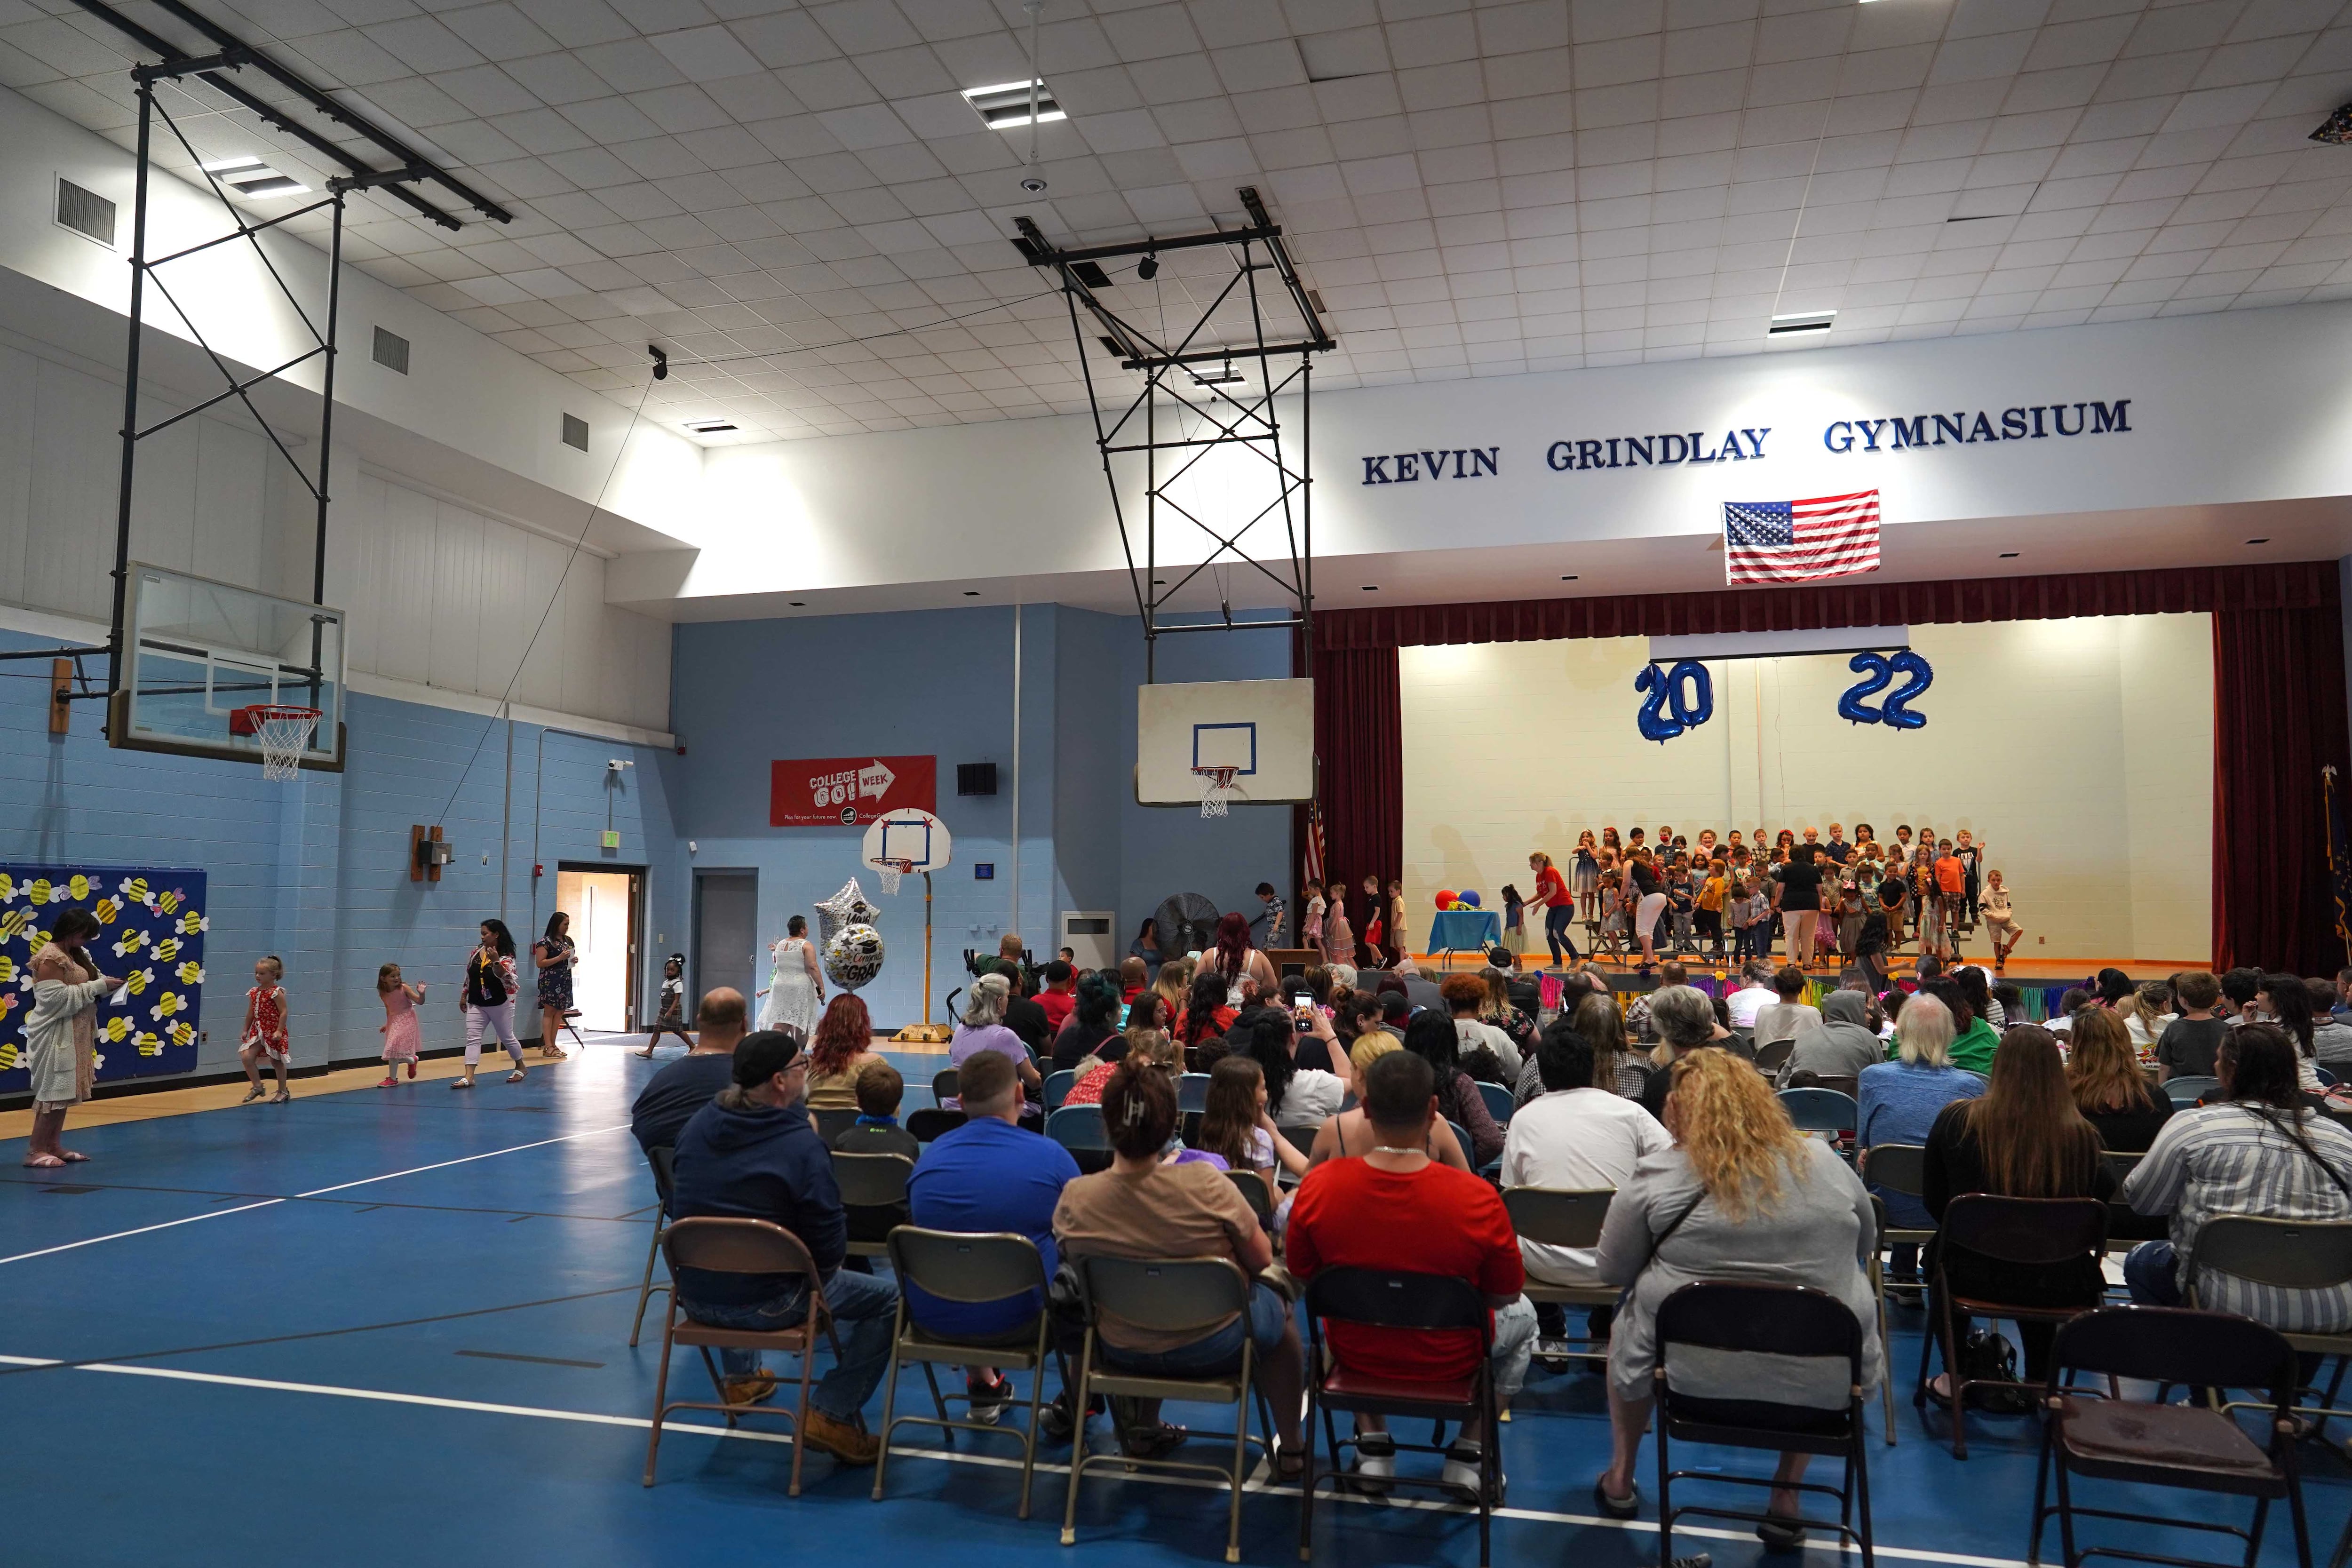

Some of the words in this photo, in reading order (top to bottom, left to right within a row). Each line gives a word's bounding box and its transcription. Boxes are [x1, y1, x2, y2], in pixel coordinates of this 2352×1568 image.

[1362, 447, 1500, 485] KEVIN
[1546, 428, 1772, 471] GRINDLAY
[1824, 399, 2132, 454] GYMNASIUM
[1635, 660, 1713, 744] 20
[1837, 650, 1933, 732] 22
[809, 770, 856, 789] COLLEGE
[862, 773, 888, 787] WEEK
[814, 781, 856, 807] GO!
